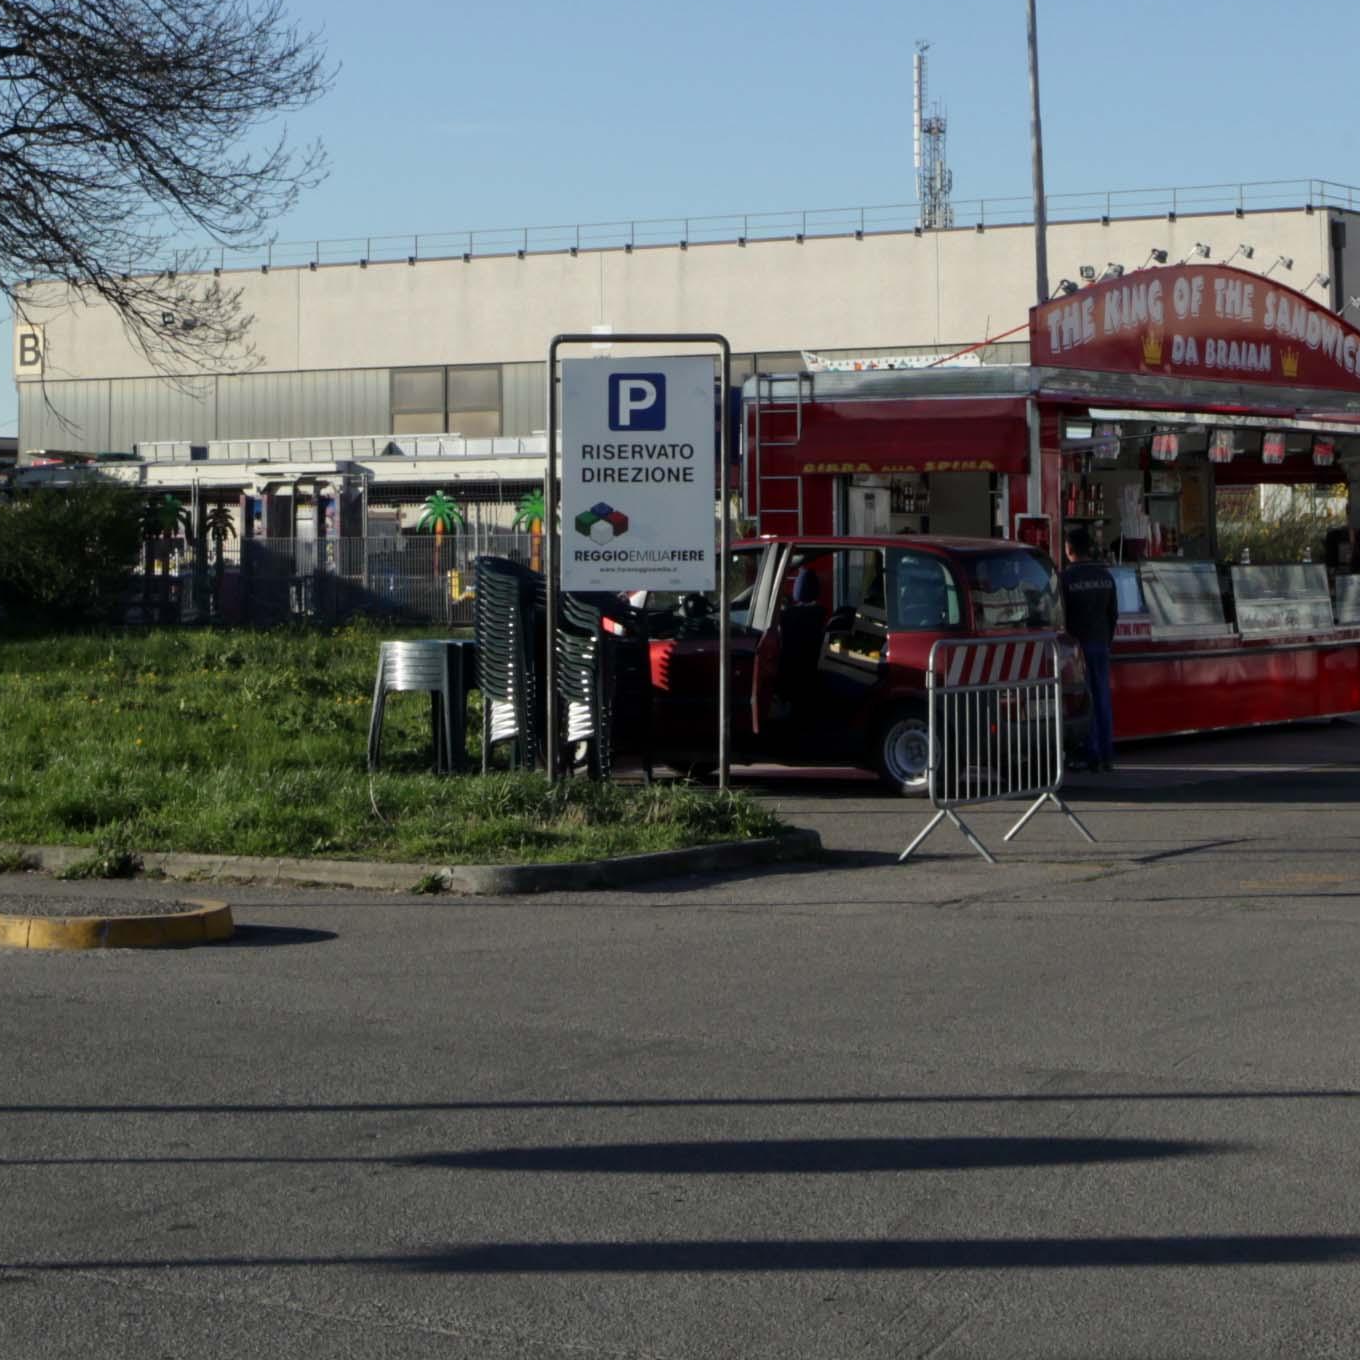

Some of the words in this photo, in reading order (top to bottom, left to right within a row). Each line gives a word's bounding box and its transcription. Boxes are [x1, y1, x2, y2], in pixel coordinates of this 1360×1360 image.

[1048, 296, 1096, 354] THE
[1103, 279, 1164, 334] KING
[1173, 276, 1205, 319] OF
[1214, 278, 1255, 322] THE
[20, 334, 40, 366] B
[1171, 335, 1198, 365] DA
[1205, 338, 1272, 371] BRAIAN
[619, 380, 656, 425] P
[582, 443, 694, 460] RISERVATO
[582, 467, 695, 483] DIREZIONE
[574, 549, 705, 562] REGGIOEMILIAFIERE
